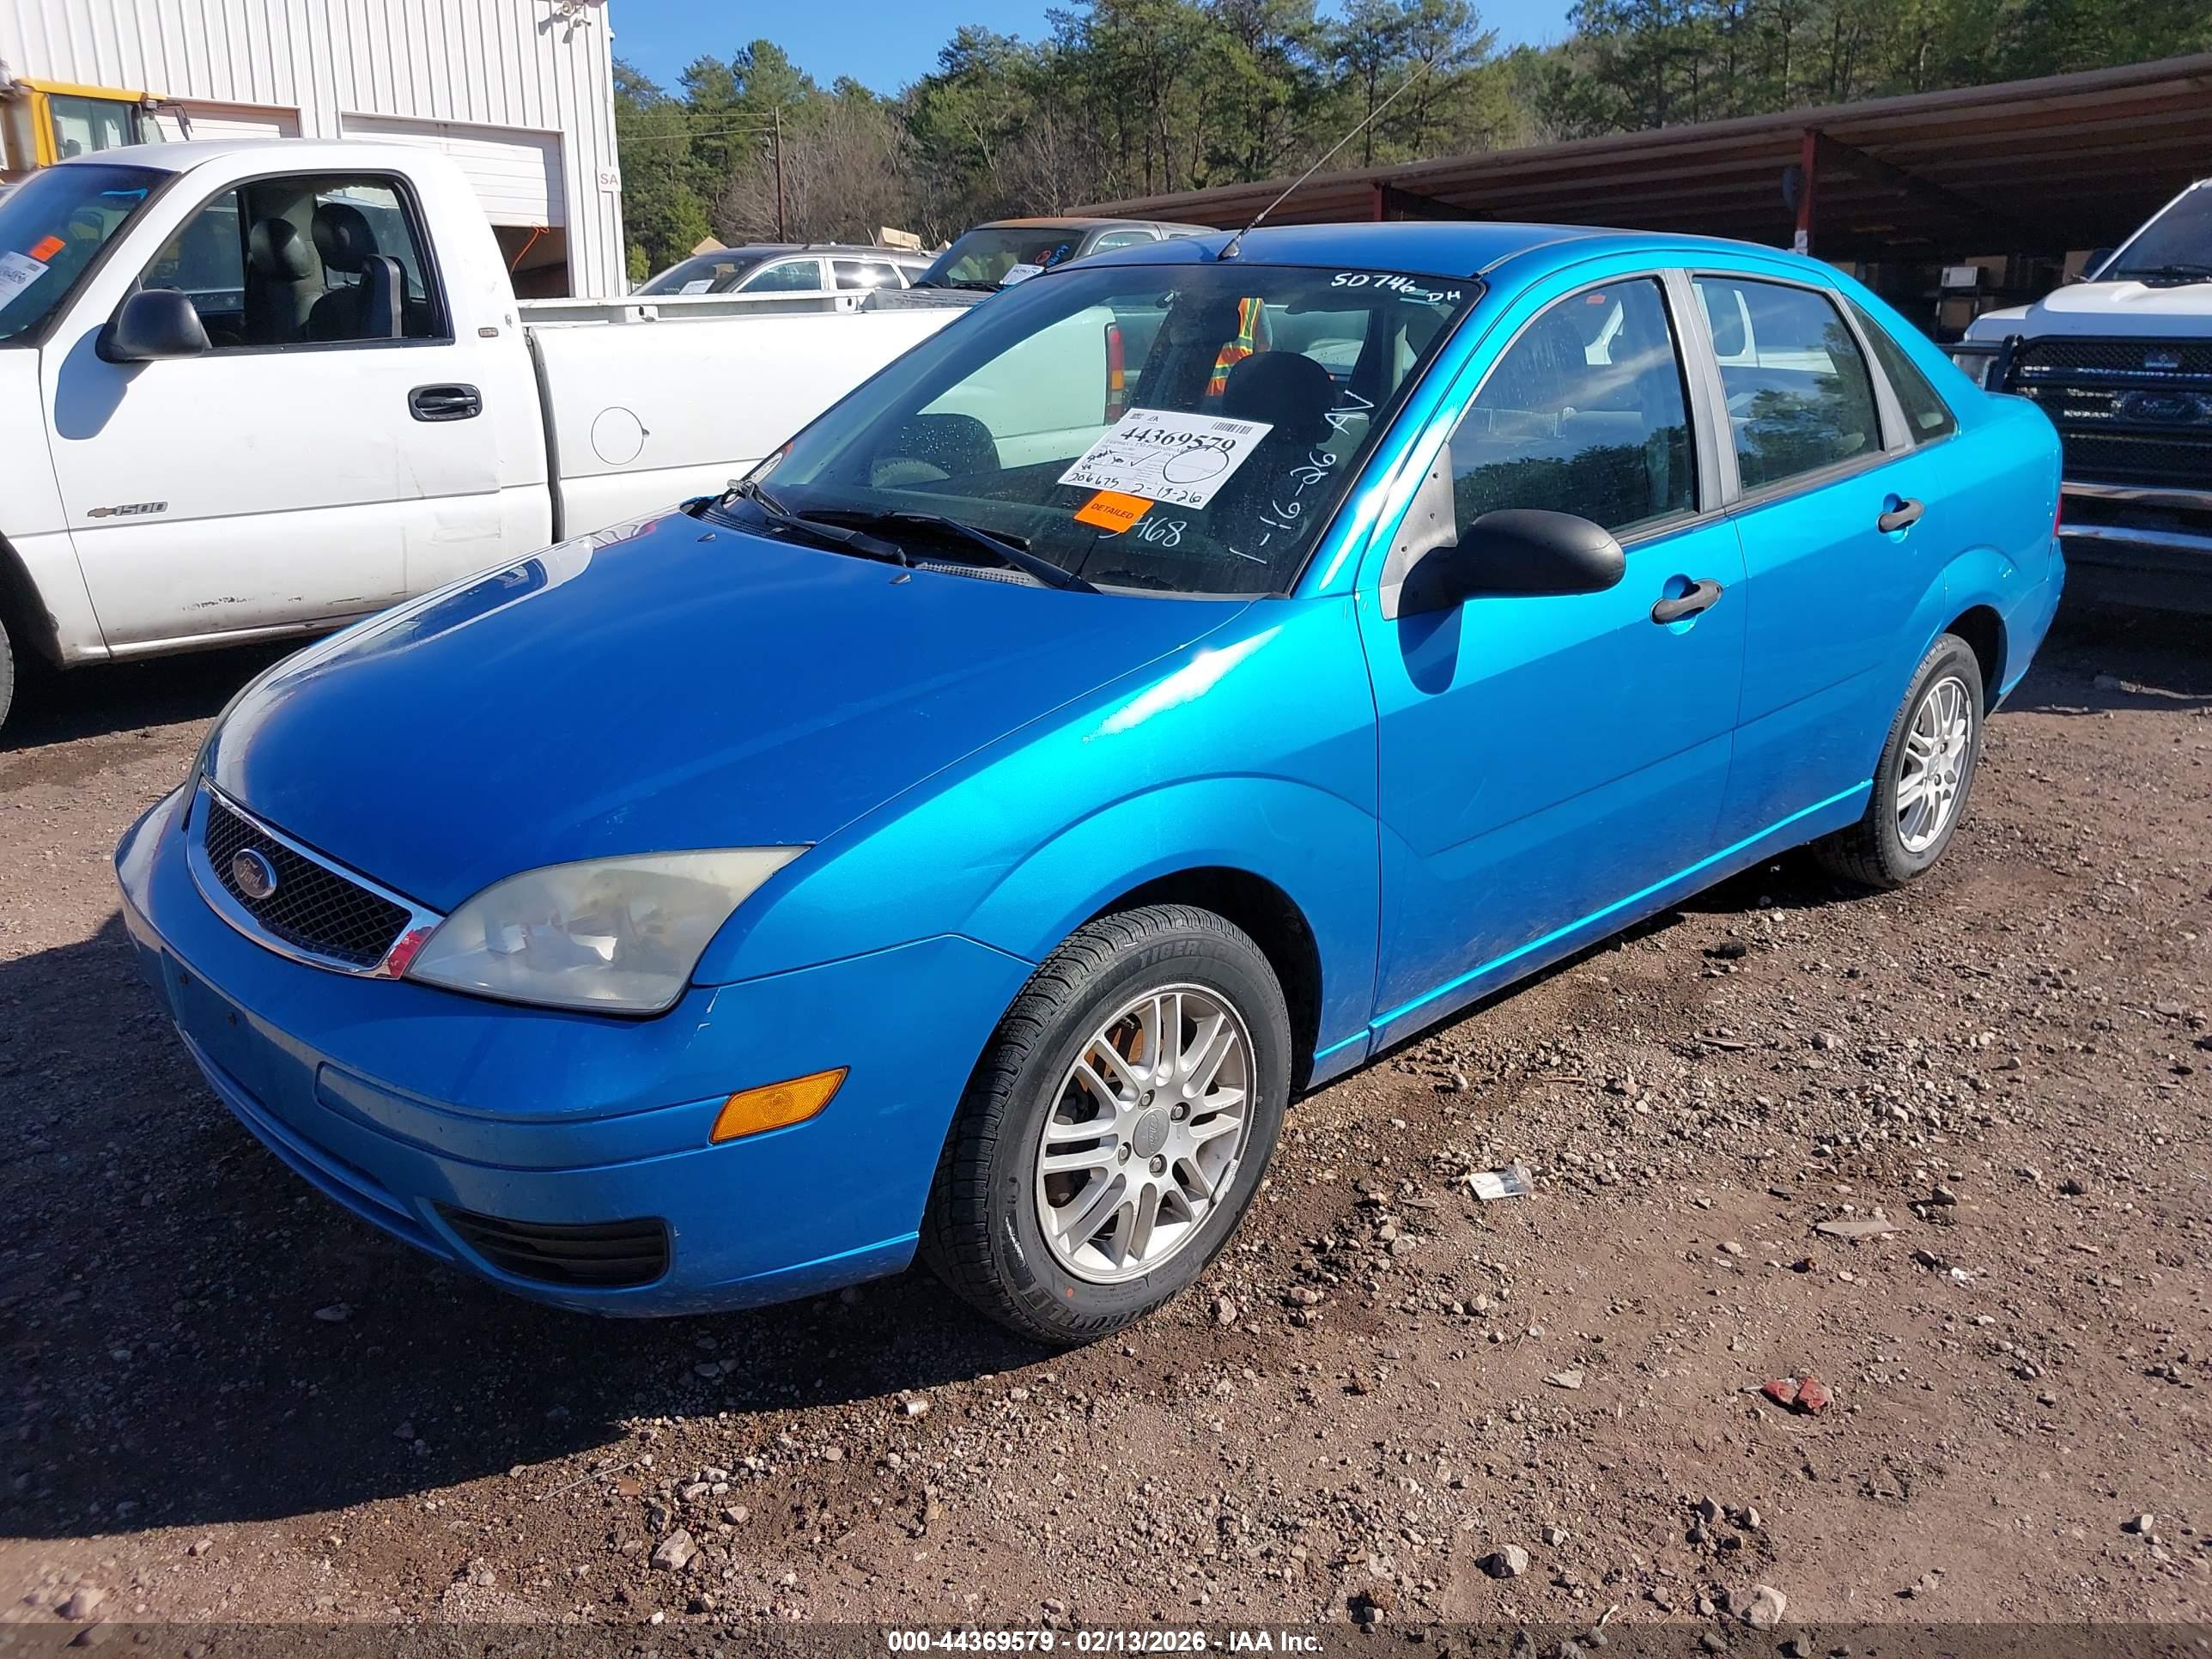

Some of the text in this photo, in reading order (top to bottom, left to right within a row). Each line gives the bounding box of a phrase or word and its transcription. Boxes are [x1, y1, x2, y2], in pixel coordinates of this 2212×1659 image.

[599, 173, 619, 185] SA
[1120, 427, 1237, 454] 44369579
[115, 501, 168, 517] 1500
[1090, 502, 1134, 520] DETAILED
[1139, 940, 1197, 969] TIGER
